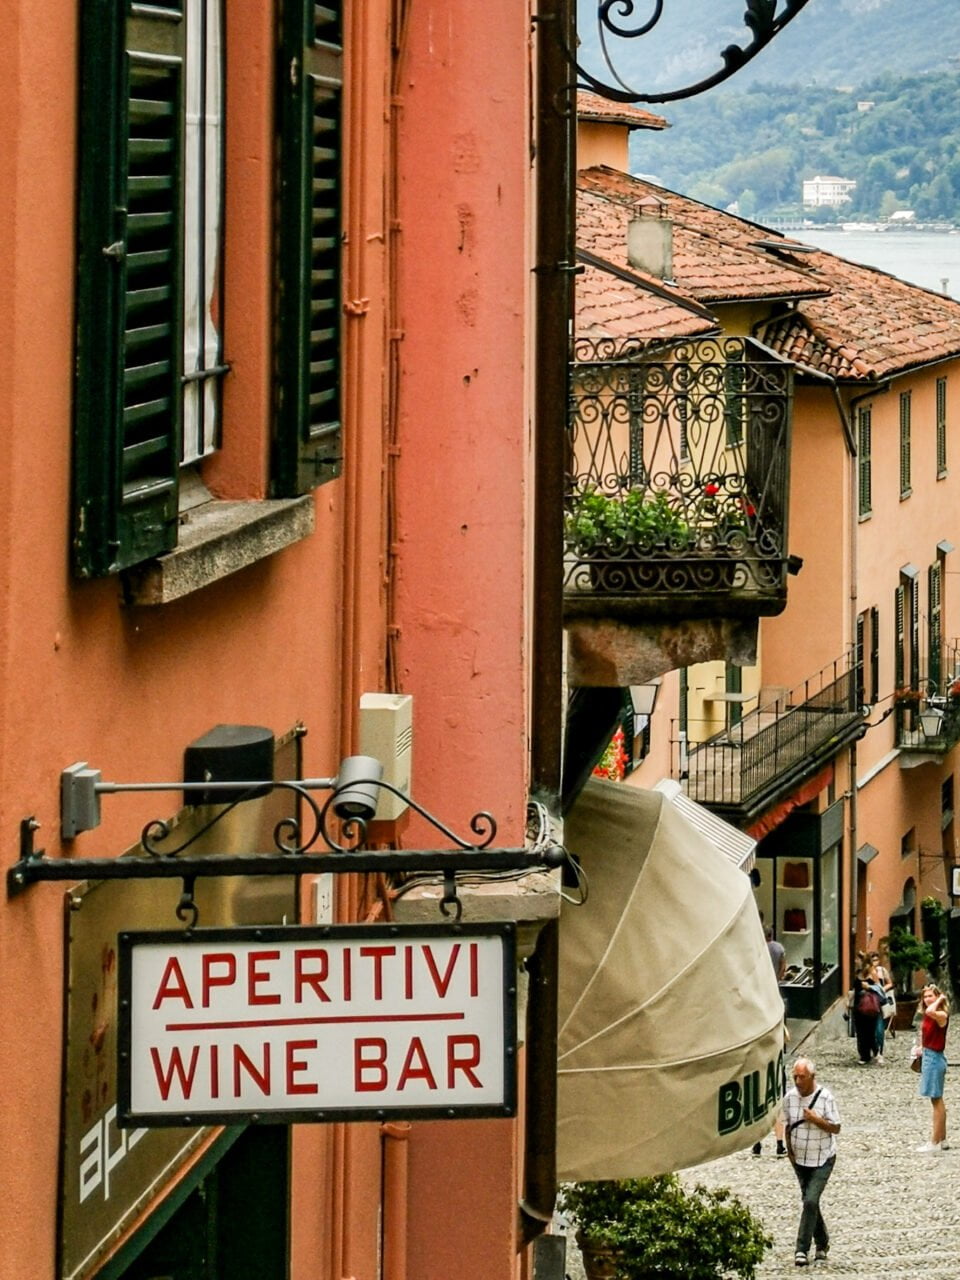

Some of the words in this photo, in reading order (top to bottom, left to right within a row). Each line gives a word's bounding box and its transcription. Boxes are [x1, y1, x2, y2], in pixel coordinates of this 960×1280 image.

[152, 943, 479, 1010] APERITIVI
[150, 1039, 319, 1101] WINE
[353, 1034, 484, 1093] BAR
